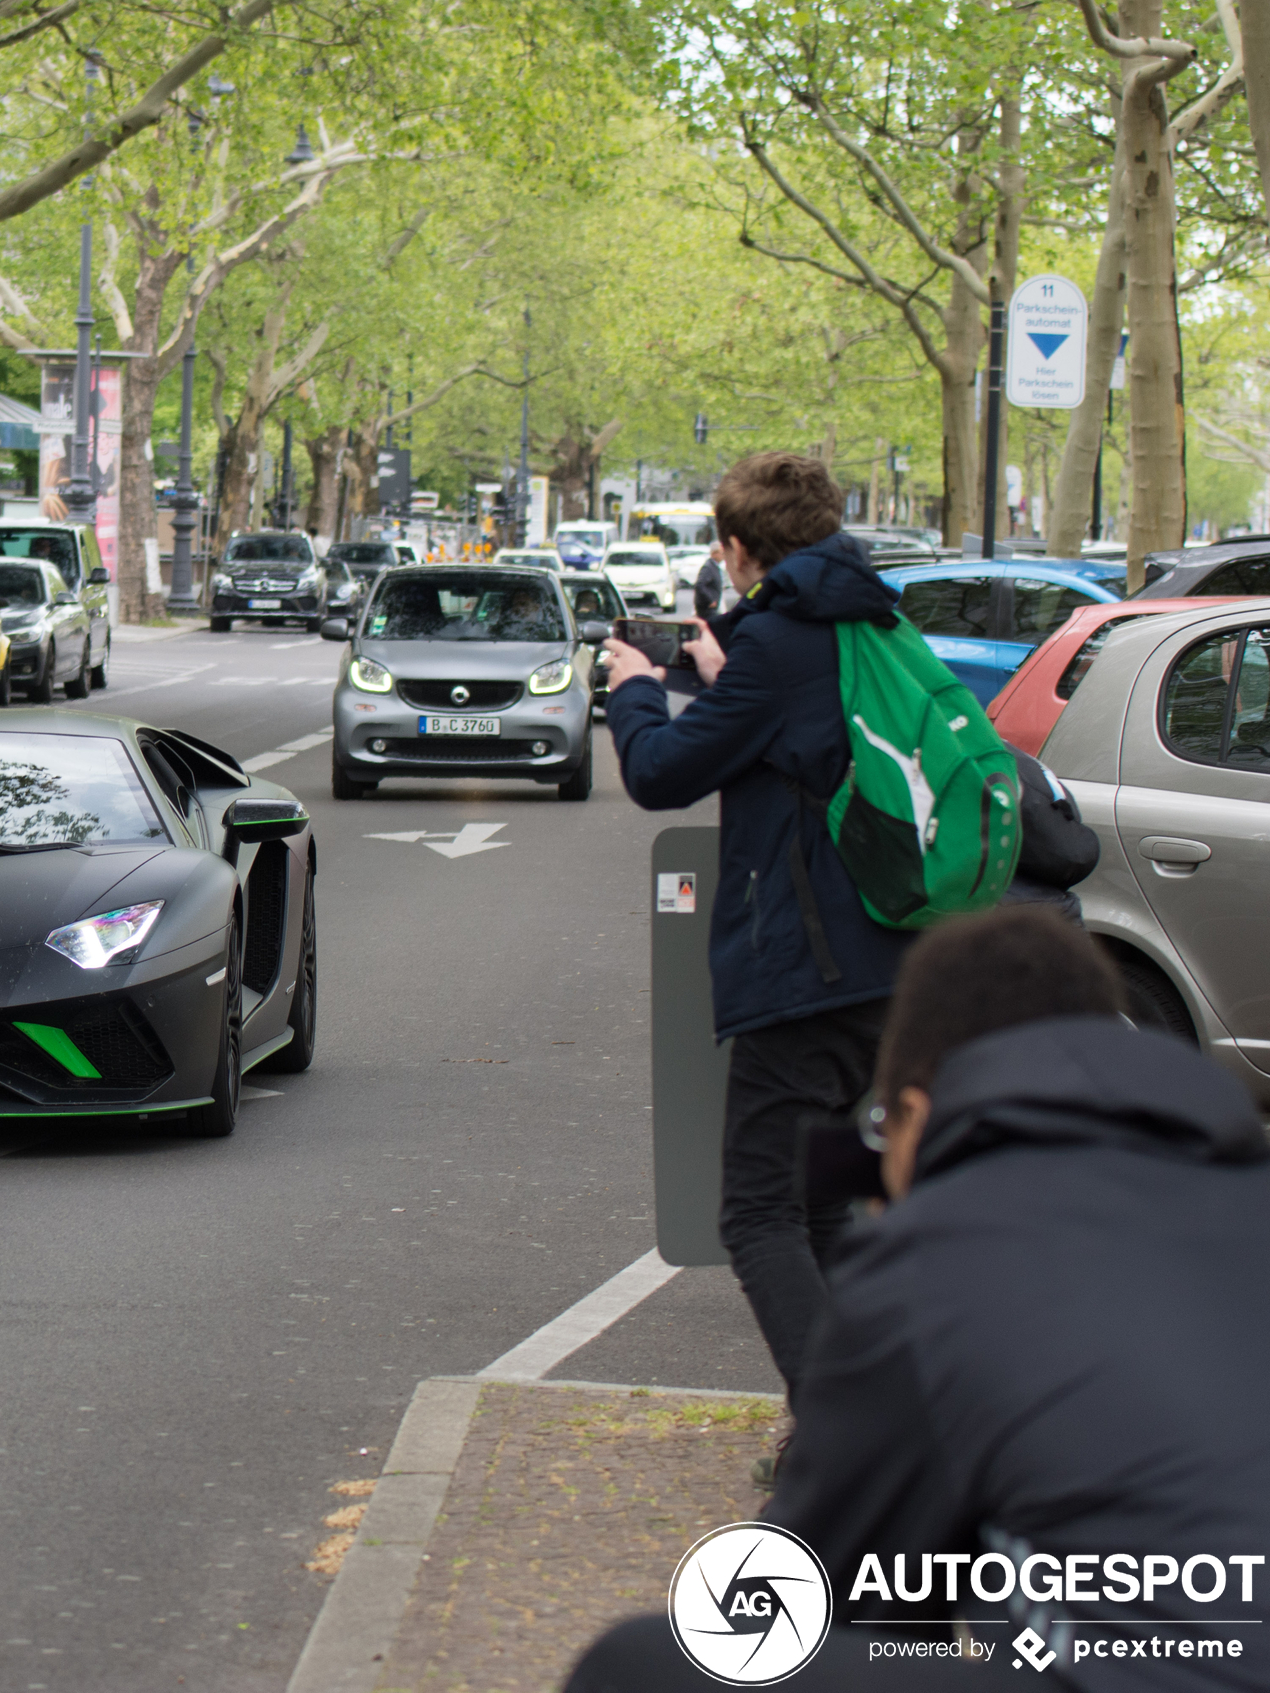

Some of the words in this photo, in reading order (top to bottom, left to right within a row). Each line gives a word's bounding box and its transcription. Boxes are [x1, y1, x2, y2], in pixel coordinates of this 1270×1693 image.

[1041, 284, 1054, 298] 11
[1016, 302, 1083, 316] Parkschein-
[1025, 318, 1072, 328] automat
[1035, 366, 1057, 376] Hier
[1018, 377, 1074, 389] Parkschein
[1031, 390, 1060, 400] lösen
[432, 719, 441, 732] B
[449, 719, 458, 732] C
[461, 719, 494, 733] 3760
